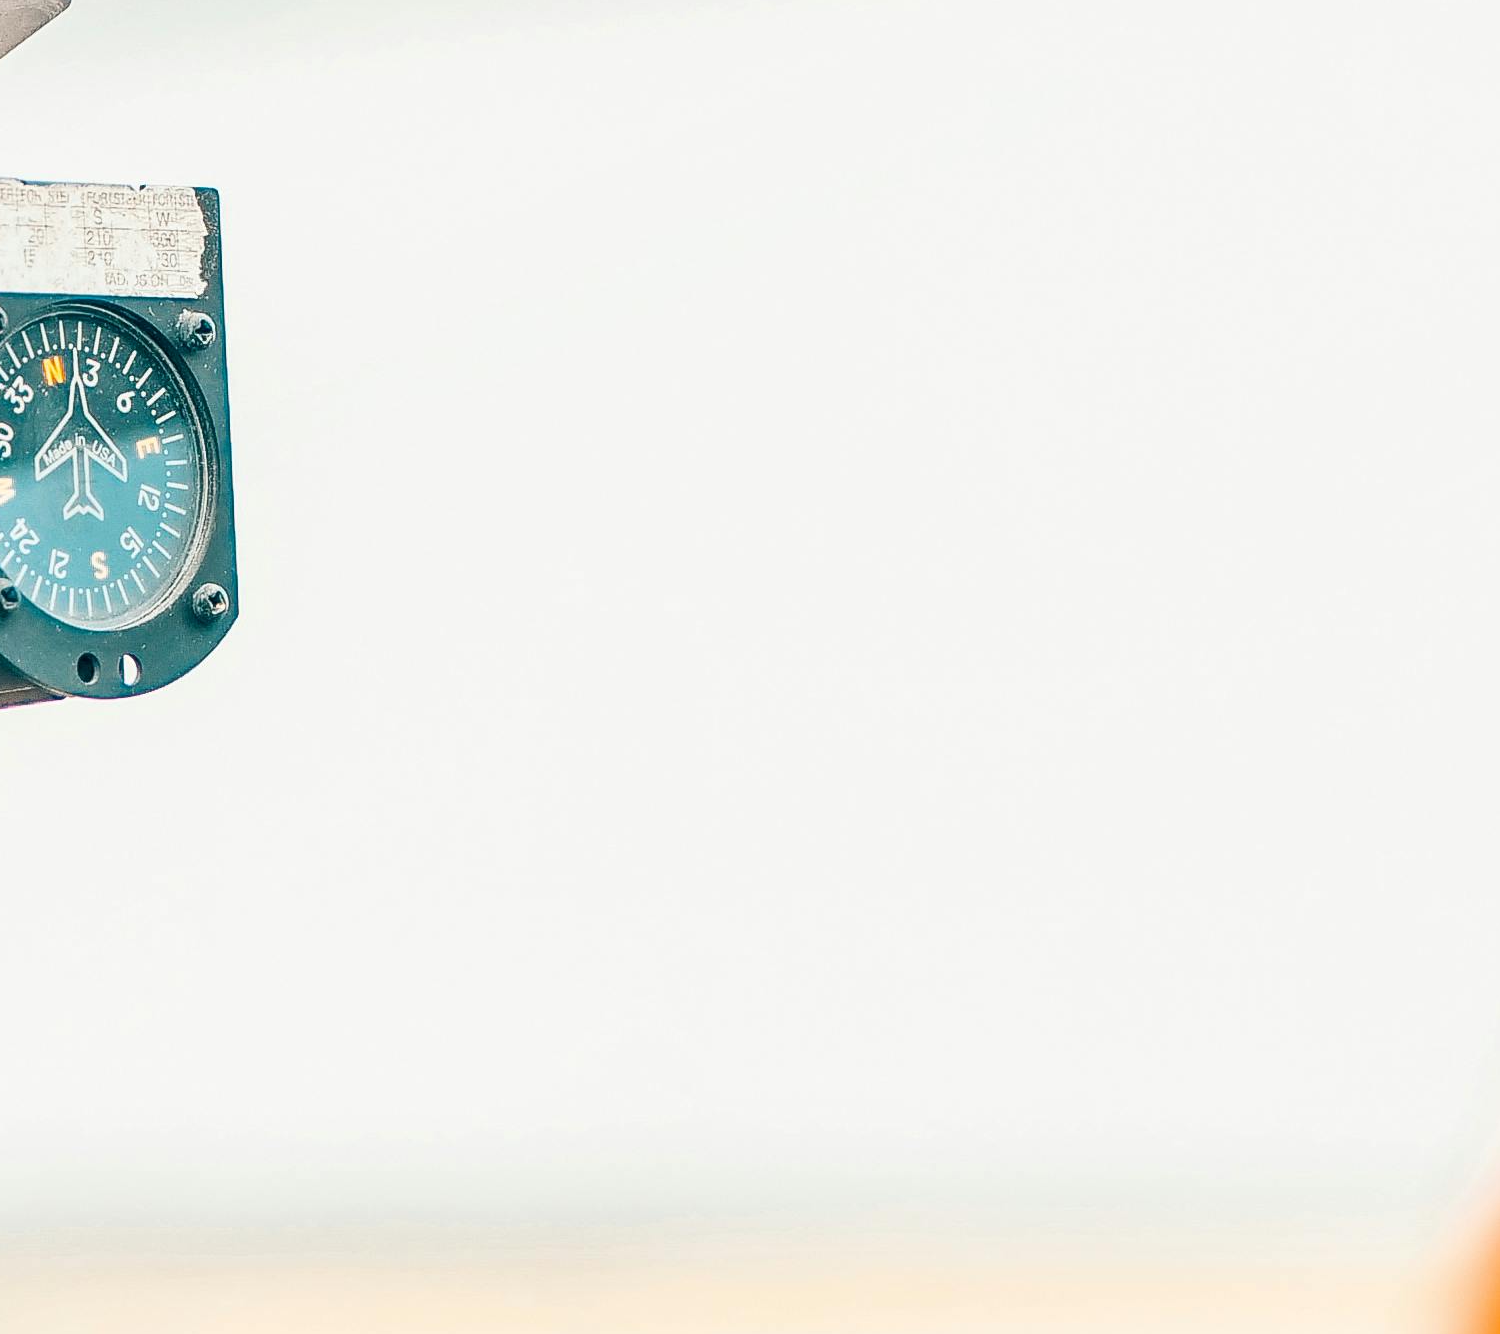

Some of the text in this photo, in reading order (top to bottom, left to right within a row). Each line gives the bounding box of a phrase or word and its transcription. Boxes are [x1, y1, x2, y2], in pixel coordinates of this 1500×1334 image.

[93, 208, 103, 226] S
[156, 210, 171, 228] W
[42, 356, 66, 387] N
[83, 358, 101, 387] 3
[4, 375, 34, 415] 33
[116, 390, 136, 413] 6
[42, 432, 117, 468] Made in USA
[135, 435, 161, 460] E
[137, 483, 162, 512] 12
[9, 517, 41, 556] 24
[119, 525, 145, 560] 15
[49, 548, 70, 580] 21
[90, 550, 110, 580] S
